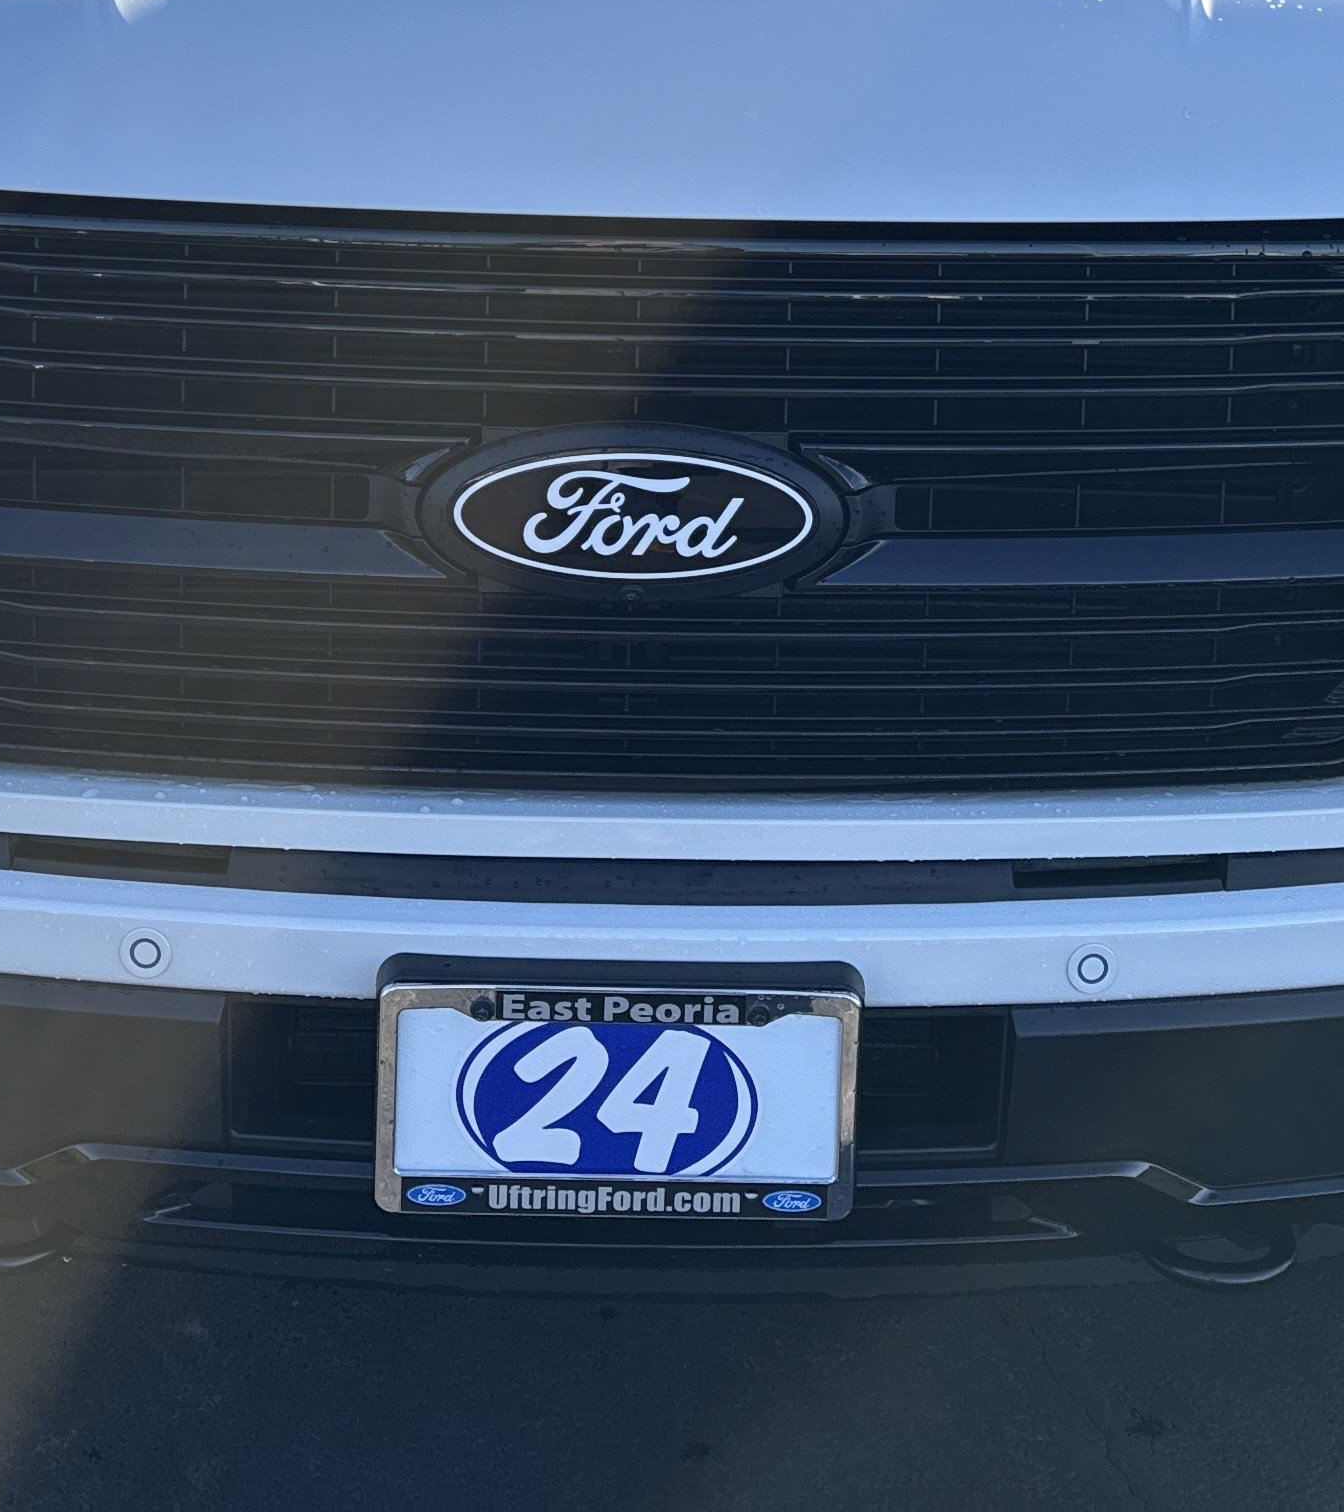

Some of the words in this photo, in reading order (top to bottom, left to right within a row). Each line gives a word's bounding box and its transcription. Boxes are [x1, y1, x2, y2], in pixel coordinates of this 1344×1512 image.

[522, 469, 745, 559] Ford
[502, 993, 592, 1022] East
[603, 995, 740, 1023] Peoria
[492, 1025, 712, 1174] 24
[416, 1186, 456, 1203] Ford
[487, 1183, 742, 1214] UftringFord.com
[773, 1192, 810, 1209] Ford
